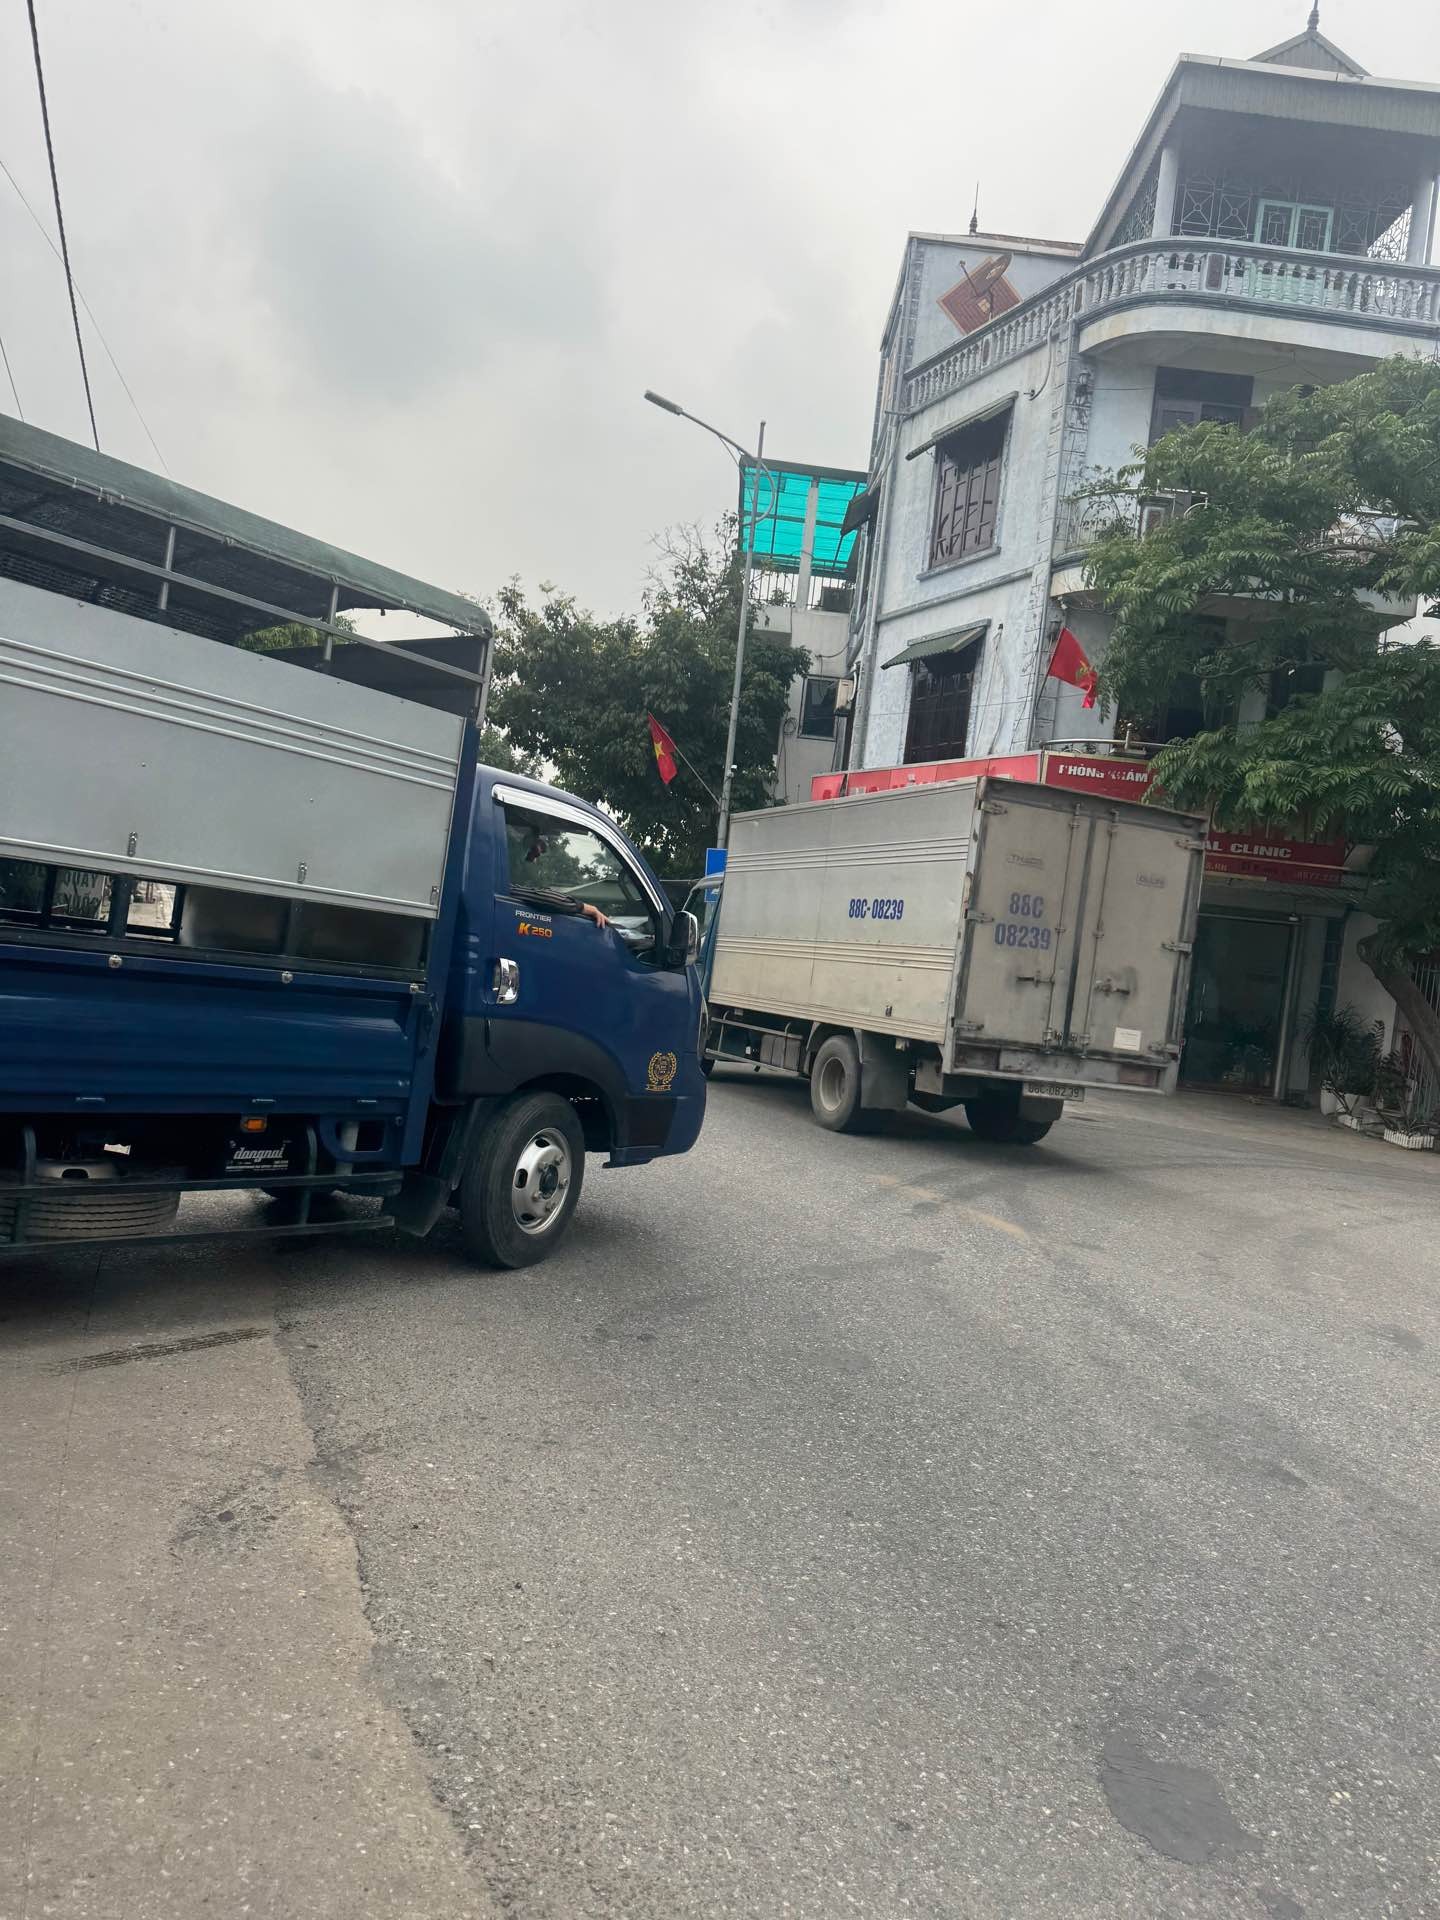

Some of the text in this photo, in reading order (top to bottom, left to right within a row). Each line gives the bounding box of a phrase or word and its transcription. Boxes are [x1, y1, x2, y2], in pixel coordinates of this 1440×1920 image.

[1230, 843, 1292, 858] CLINIC
[848, 898, 904, 920] 88C-08239
[1009, 892, 1044, 919] 88C
[515, 909, 552, 923] FRONTIER
[517, 922, 553, 938] K 250
[994, 923, 1050, 950] 08239
